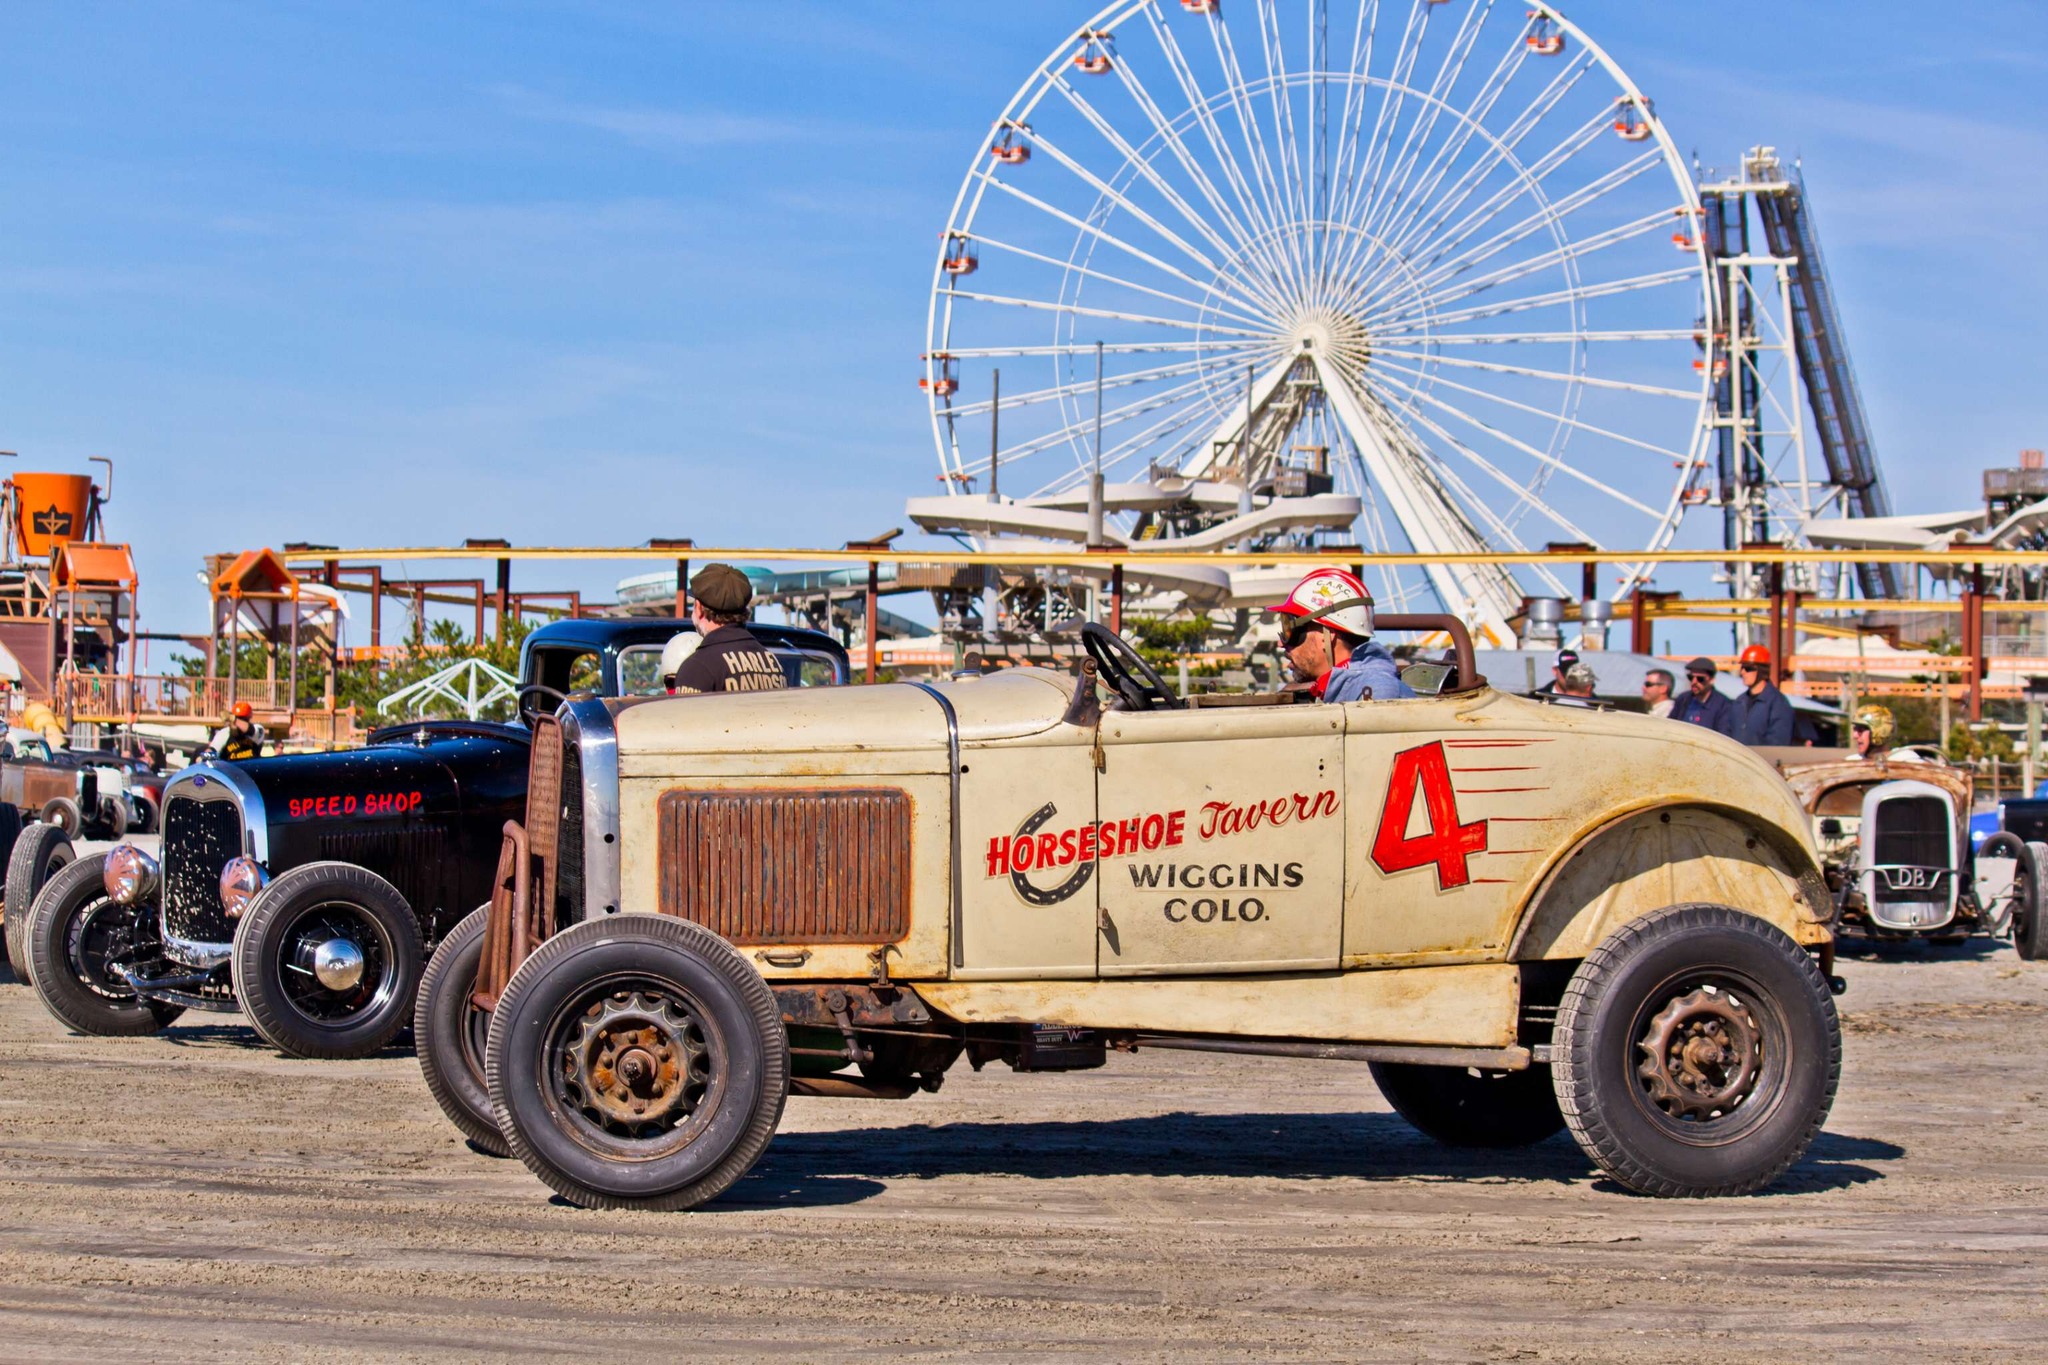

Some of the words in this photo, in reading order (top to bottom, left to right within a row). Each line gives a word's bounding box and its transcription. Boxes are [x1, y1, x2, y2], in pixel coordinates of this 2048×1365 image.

[288, 796, 357, 818] SPEED
[364, 791, 422, 815] SHOP
[1371, 739, 1488, 891] 4
[985, 809, 1186, 877] HORSESHOE
[1199, 789, 1341, 839] Tavern
[1127, 862, 1305, 888] WIGGINS
[1898, 868, 1925, 887] DB
[1163, 897, 1271, 923] COLO.
